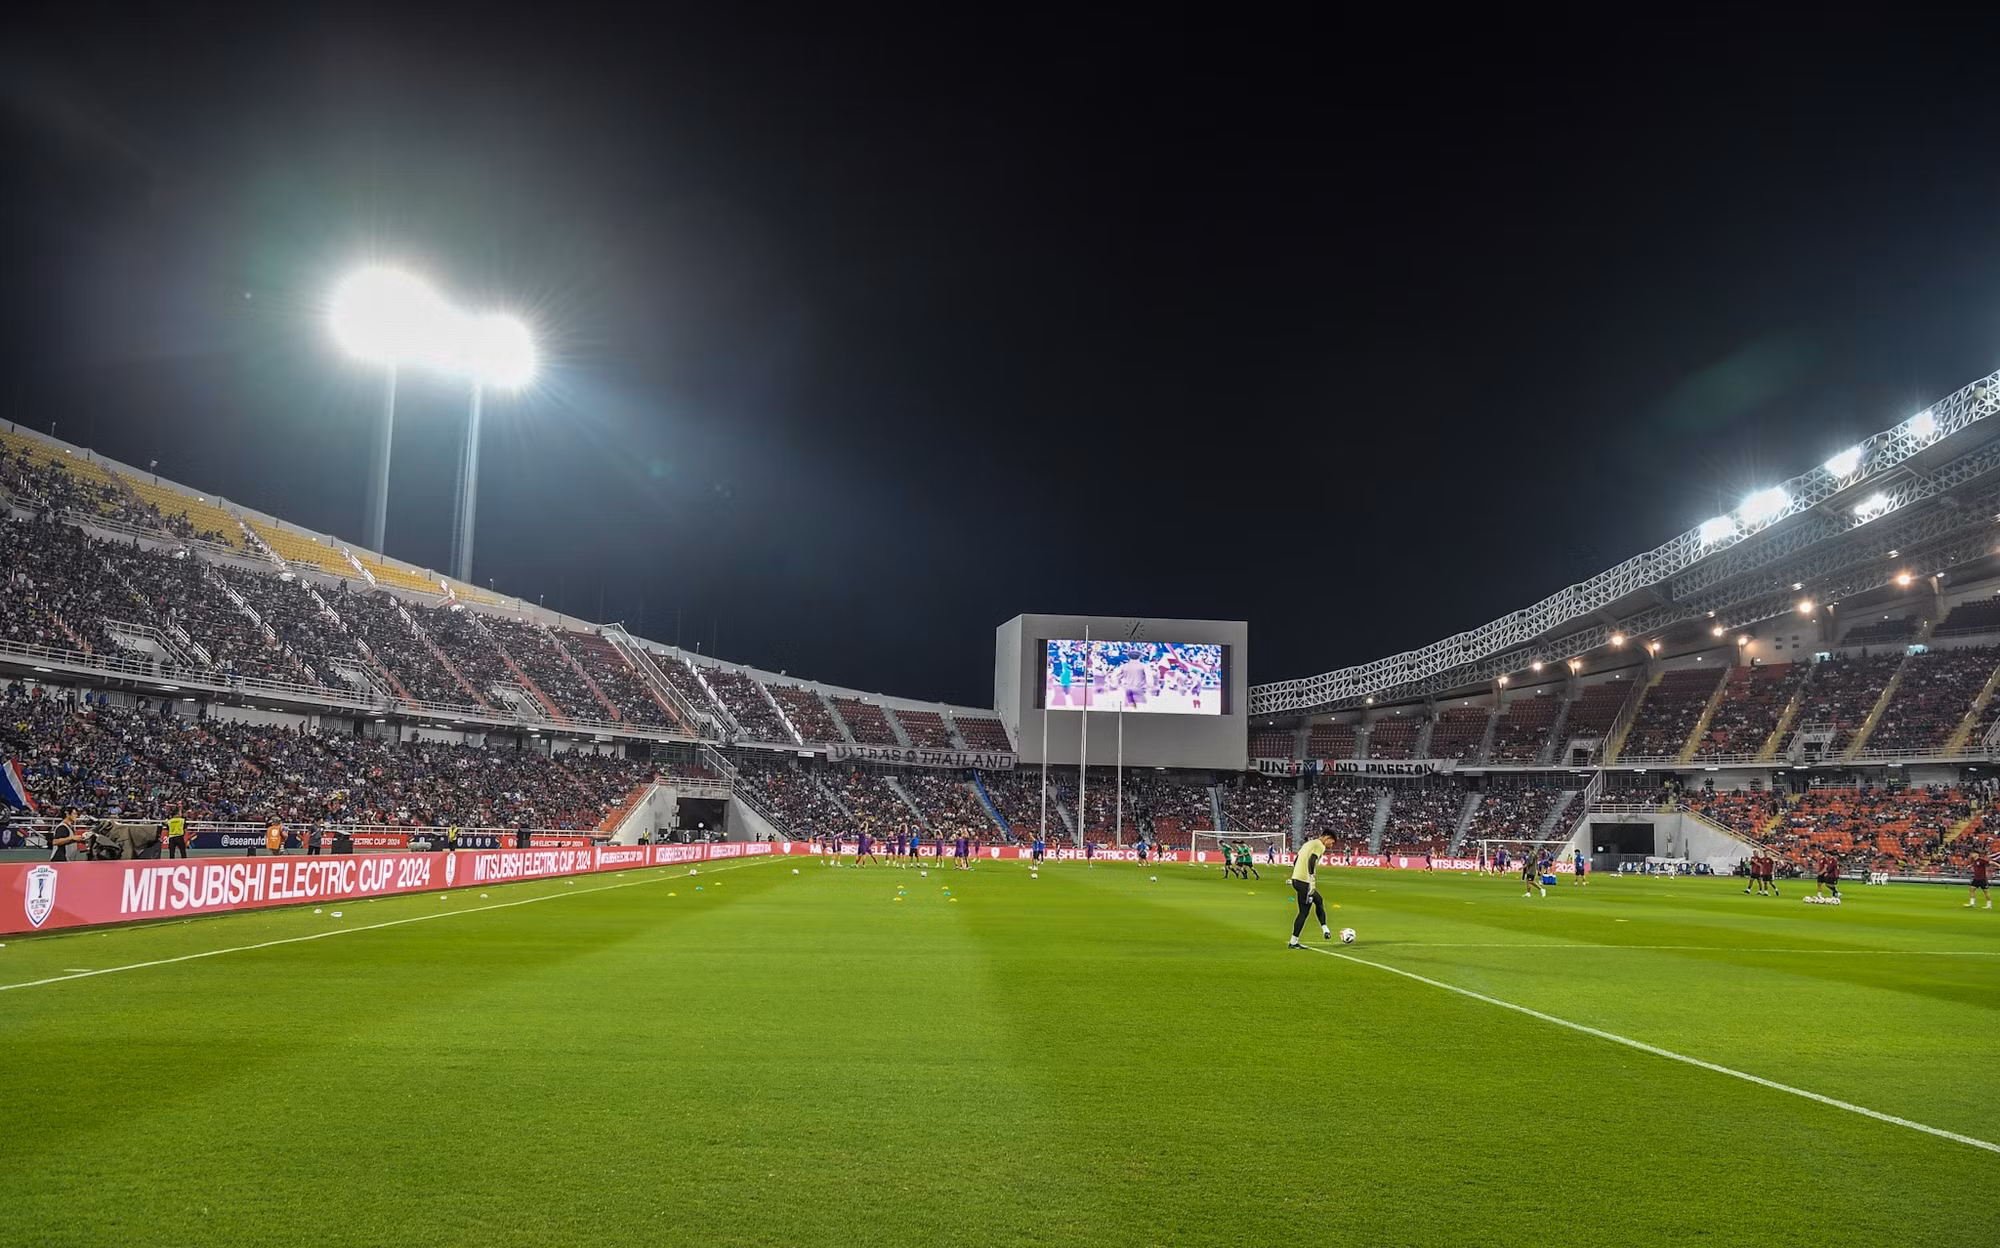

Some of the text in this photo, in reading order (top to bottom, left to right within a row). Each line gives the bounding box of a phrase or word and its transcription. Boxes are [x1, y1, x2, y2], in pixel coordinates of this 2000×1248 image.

[920, 751, 1012, 768] THAILAND
[1260, 760, 1435, 775] UNITY AND PASSION
[374, 838, 386, 846] CUP
[919, 846, 937, 857] CU
[474, 852, 524, 880] MITSUBISHI
[524, 851, 559, 876] ELECTRIC
[560, 850, 575, 872] CUP
[576, 850, 591, 870] 2024
[1356, 857, 1381, 867] 2024
[1555, 862, 1576, 872] 202
[120, 857, 431, 914] MITSUBISHI ELECTRIC CUP 2024
